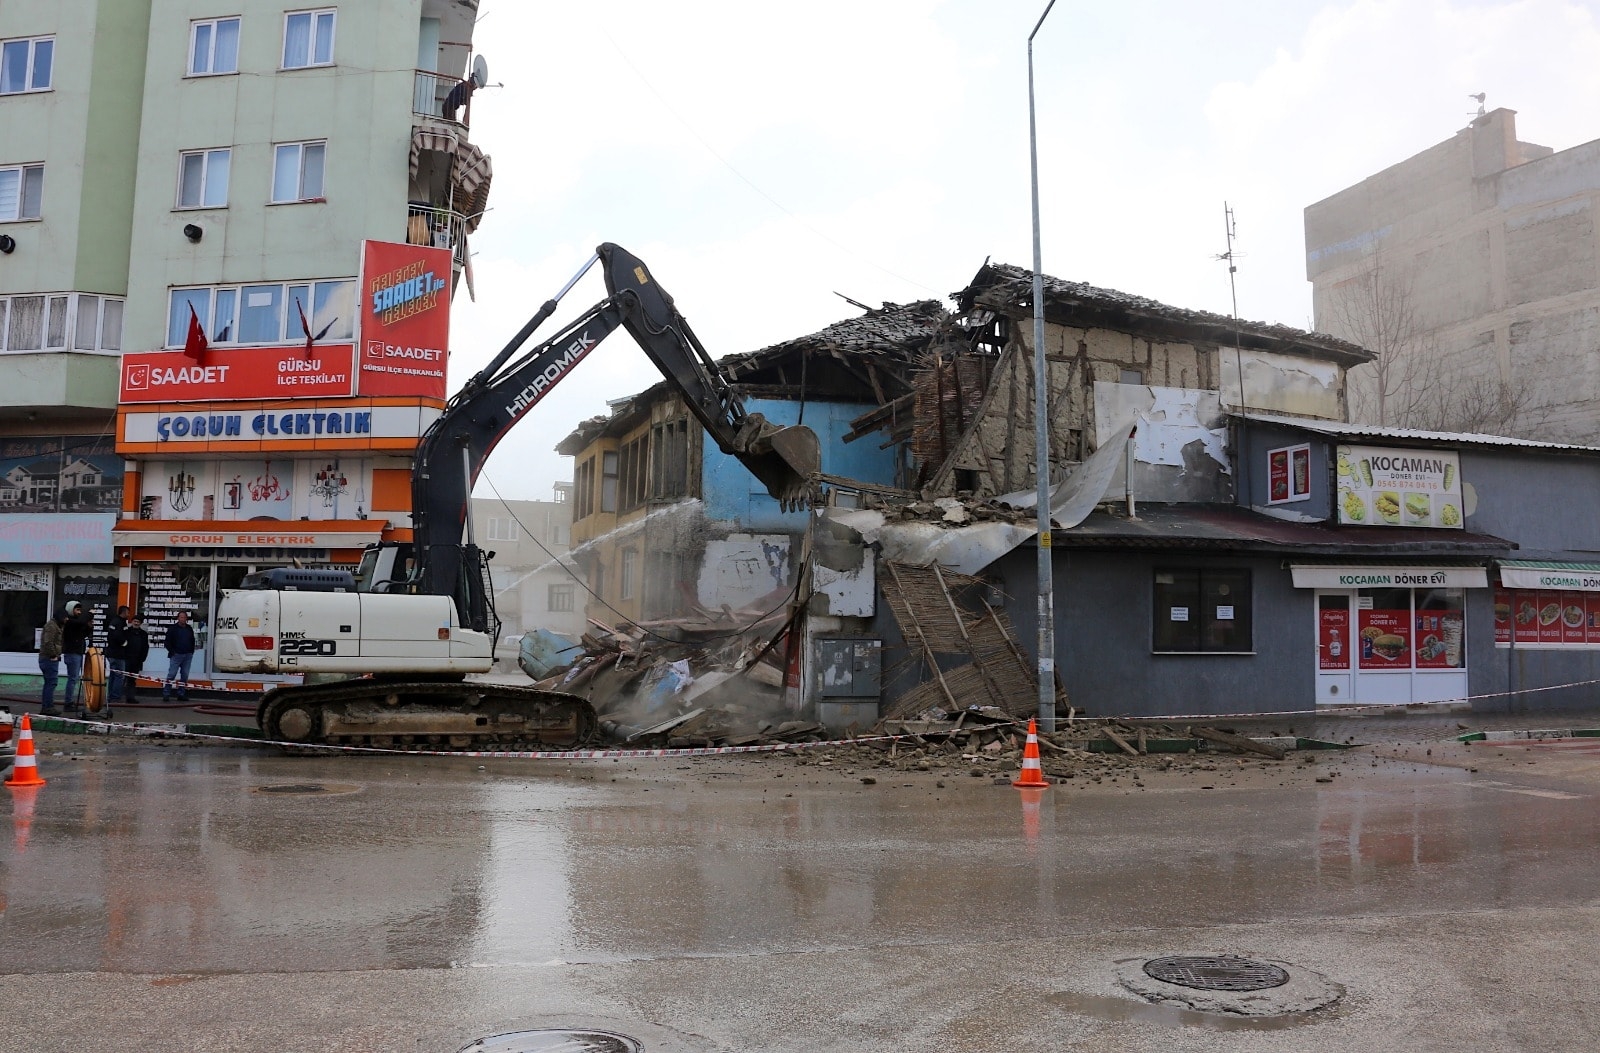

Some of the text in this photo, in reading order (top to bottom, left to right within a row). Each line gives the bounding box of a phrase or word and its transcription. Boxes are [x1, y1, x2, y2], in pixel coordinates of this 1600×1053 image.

[373, 272, 445, 313] SAADET ile
[385, 345, 442, 361] SAADET
[278, 357, 321, 373] GÜRSU
[363, 364, 444, 377] GÜRSU İLÇE BAŞKANLIĞI
[150, 365, 230, 385] SAADET
[277, 372, 345, 386] İLÇE TEŞKİLATI
[158, 415, 241, 441] ÇORUH
[1371, 456, 1443, 473] KOCAMAN
[1377, 480, 1397, 488] 0545
[169, 535, 223, 544] ÇORUH
[1339, 575, 1391, 585] KOCAMAN
[1394, 573, 1428, 584] DÖNER
[1540, 577, 1580, 587] KOCAMAN
[280, 631, 306, 639] HMK
[280, 639, 336, 656] 220
